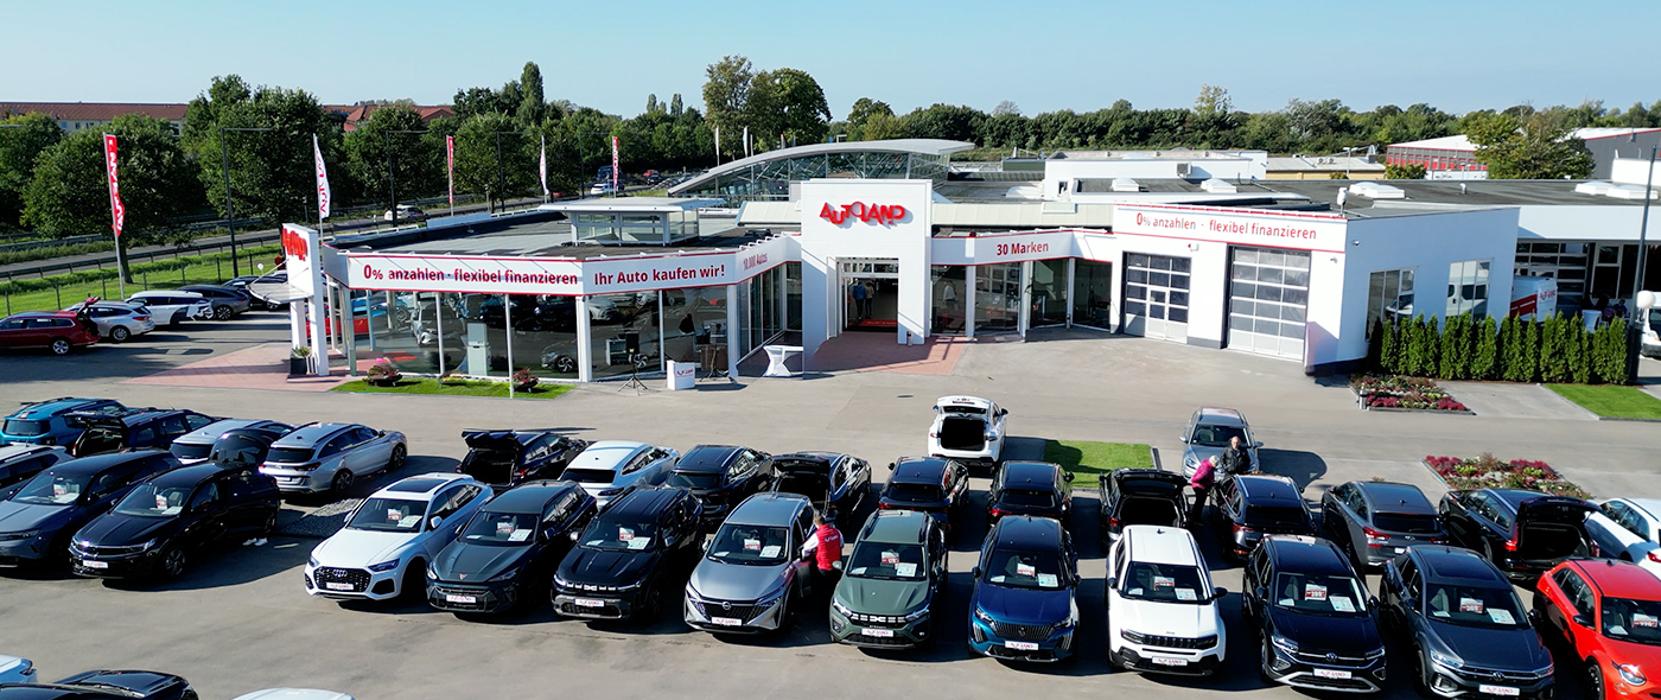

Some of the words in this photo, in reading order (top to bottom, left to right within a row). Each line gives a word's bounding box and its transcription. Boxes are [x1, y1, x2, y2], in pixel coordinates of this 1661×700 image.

[819, 201, 906, 225] AUTOLAND
[1153, 217, 1197, 230] anzahlen
[1209, 219, 1248, 233] flexibel
[1251, 222, 1317, 239] finanzieren
[997, 243, 1009, 256] 30
[1011, 242, 1049, 254] Marken
[363, 264, 384, 280] 0%
[388, 267, 445, 281] anzahlen
[454, 268, 501, 282] flexibel
[504, 269, 578, 284] finanzieren
[594, 272, 613, 285] Ihr
[617, 271, 648, 283] Auto
[653, 267, 696, 281] kaufen
[700, 264, 725, 277] wir!
